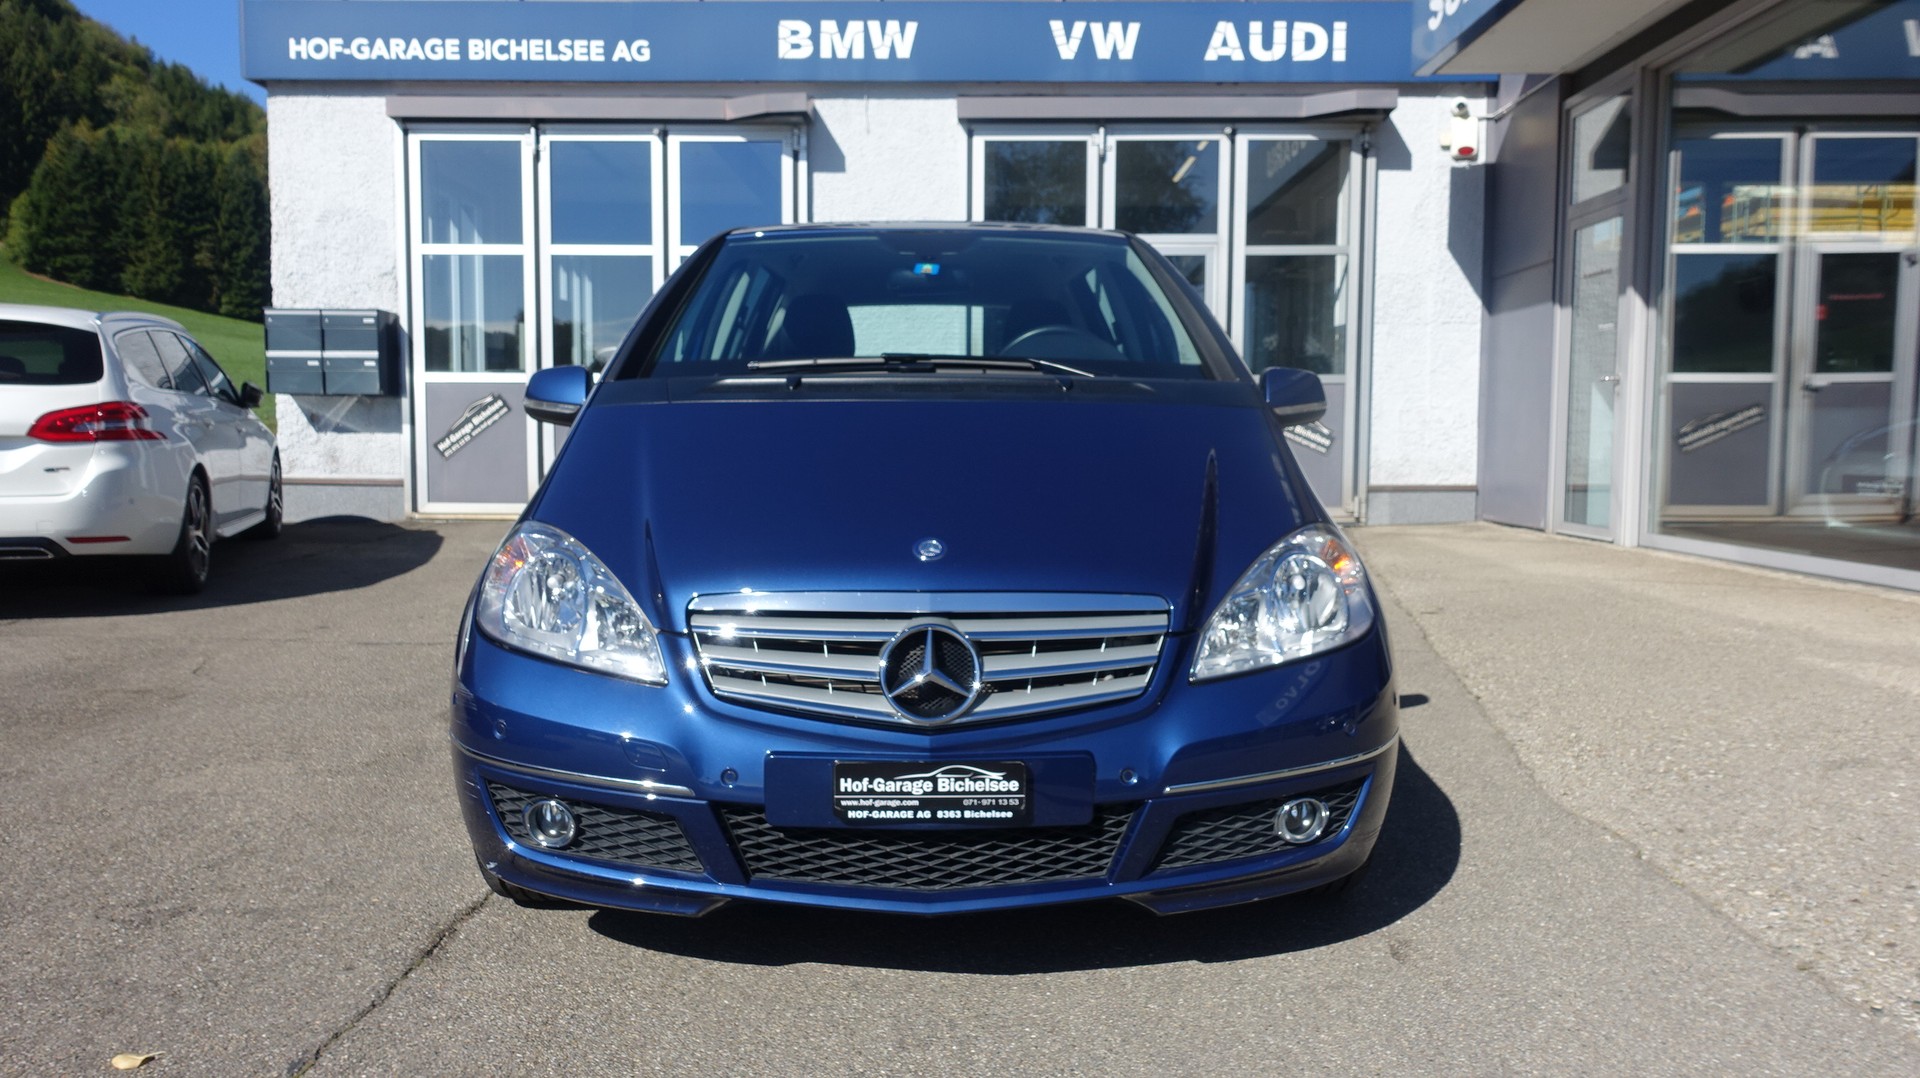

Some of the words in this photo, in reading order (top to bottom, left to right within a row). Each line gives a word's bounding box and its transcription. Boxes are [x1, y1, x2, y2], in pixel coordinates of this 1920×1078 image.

[288, 36, 461, 61] HOF-GARAGE
[467, 37, 606, 62] BICHELSEE
[611, 38, 651, 62] AG
[777, 19, 919, 60] BMW
[1048, 19, 1141, 61] VW
[1203, 20, 1348, 62] AUDI
[839, 777, 934, 795] Hof-Garage
[937, 777, 1020, 793] Bichelsee
[840, 798, 920, 808] www.hof-garage.com
[998, 798, 1008, 806] 13
[1008, 798, 1020, 806] 53
[847, 810, 915, 819] HOF-GARAGE
[915, 810, 932, 819] AG
[936, 810, 962, 819] 8363
[963, 809, 1014, 819] Bichelsee
